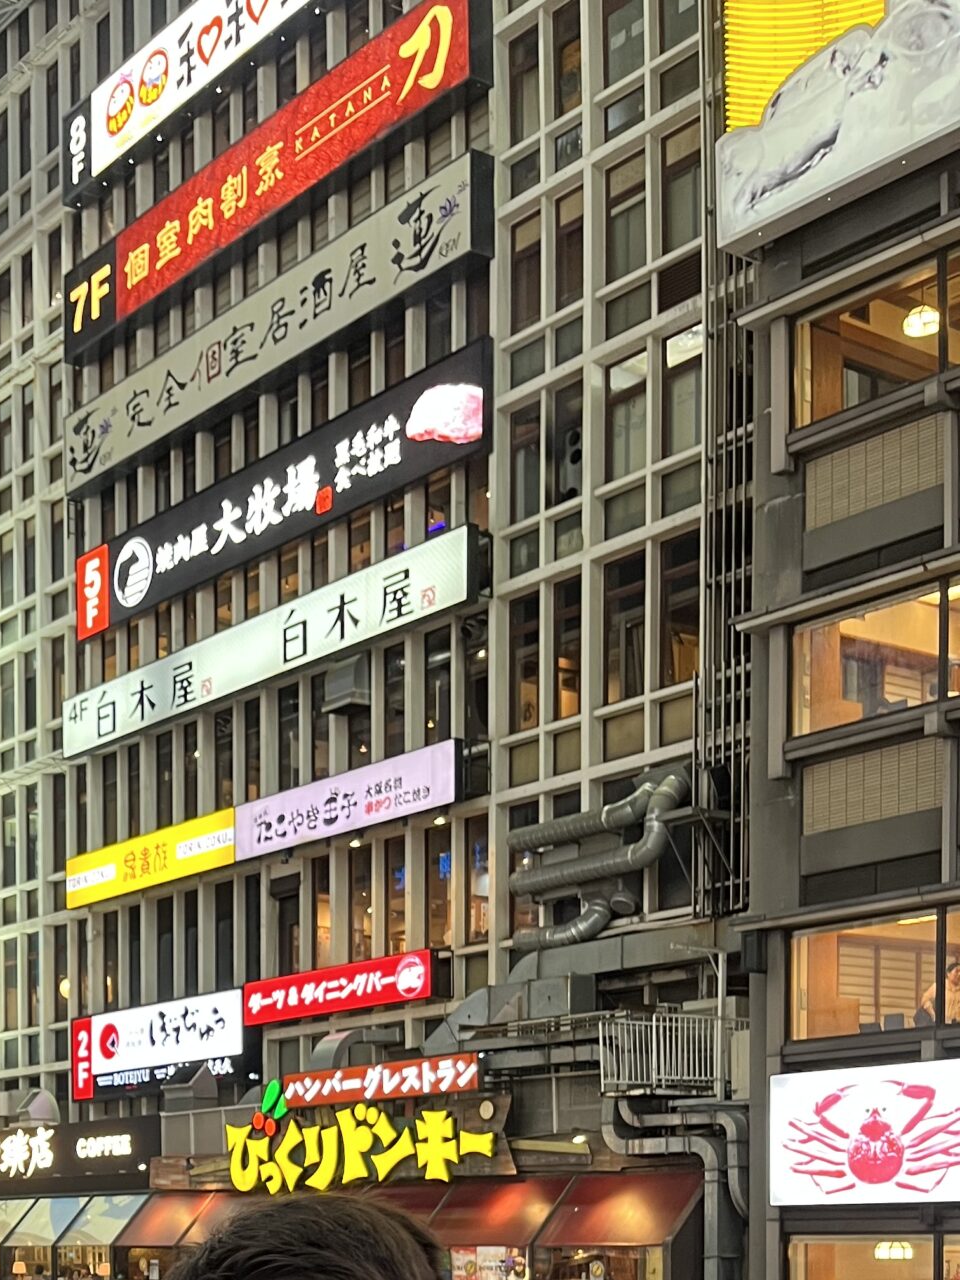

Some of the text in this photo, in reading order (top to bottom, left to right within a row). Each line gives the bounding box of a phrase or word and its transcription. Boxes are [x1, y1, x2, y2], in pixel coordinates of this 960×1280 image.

[69, 115, 87, 185] 8F
[69, 4, 454, 334] 7F 個室肉割烹 KATANA 刀
[125, 242, 377, 437] 完全個室居酒屋
[83, 557, 101, 628] 5F
[155, 524, 210, 575] 焼肉屋
[210, 455, 321, 555] 大牧場
[68, 569, 411, 738] 4F 白木屋 白木屋
[248, 990, 285, 1014] ダーツ
[301, 971, 396, 1005] ダイニングバー
[77, 1005, 226, 1088] 2F ぼてぢゅう
[285, 1059, 478, 1103] ハンバーグレストラン
[76, 1134, 132, 1159] COFFEE
[227, 1102, 494, 1195] びっくりドンキー
